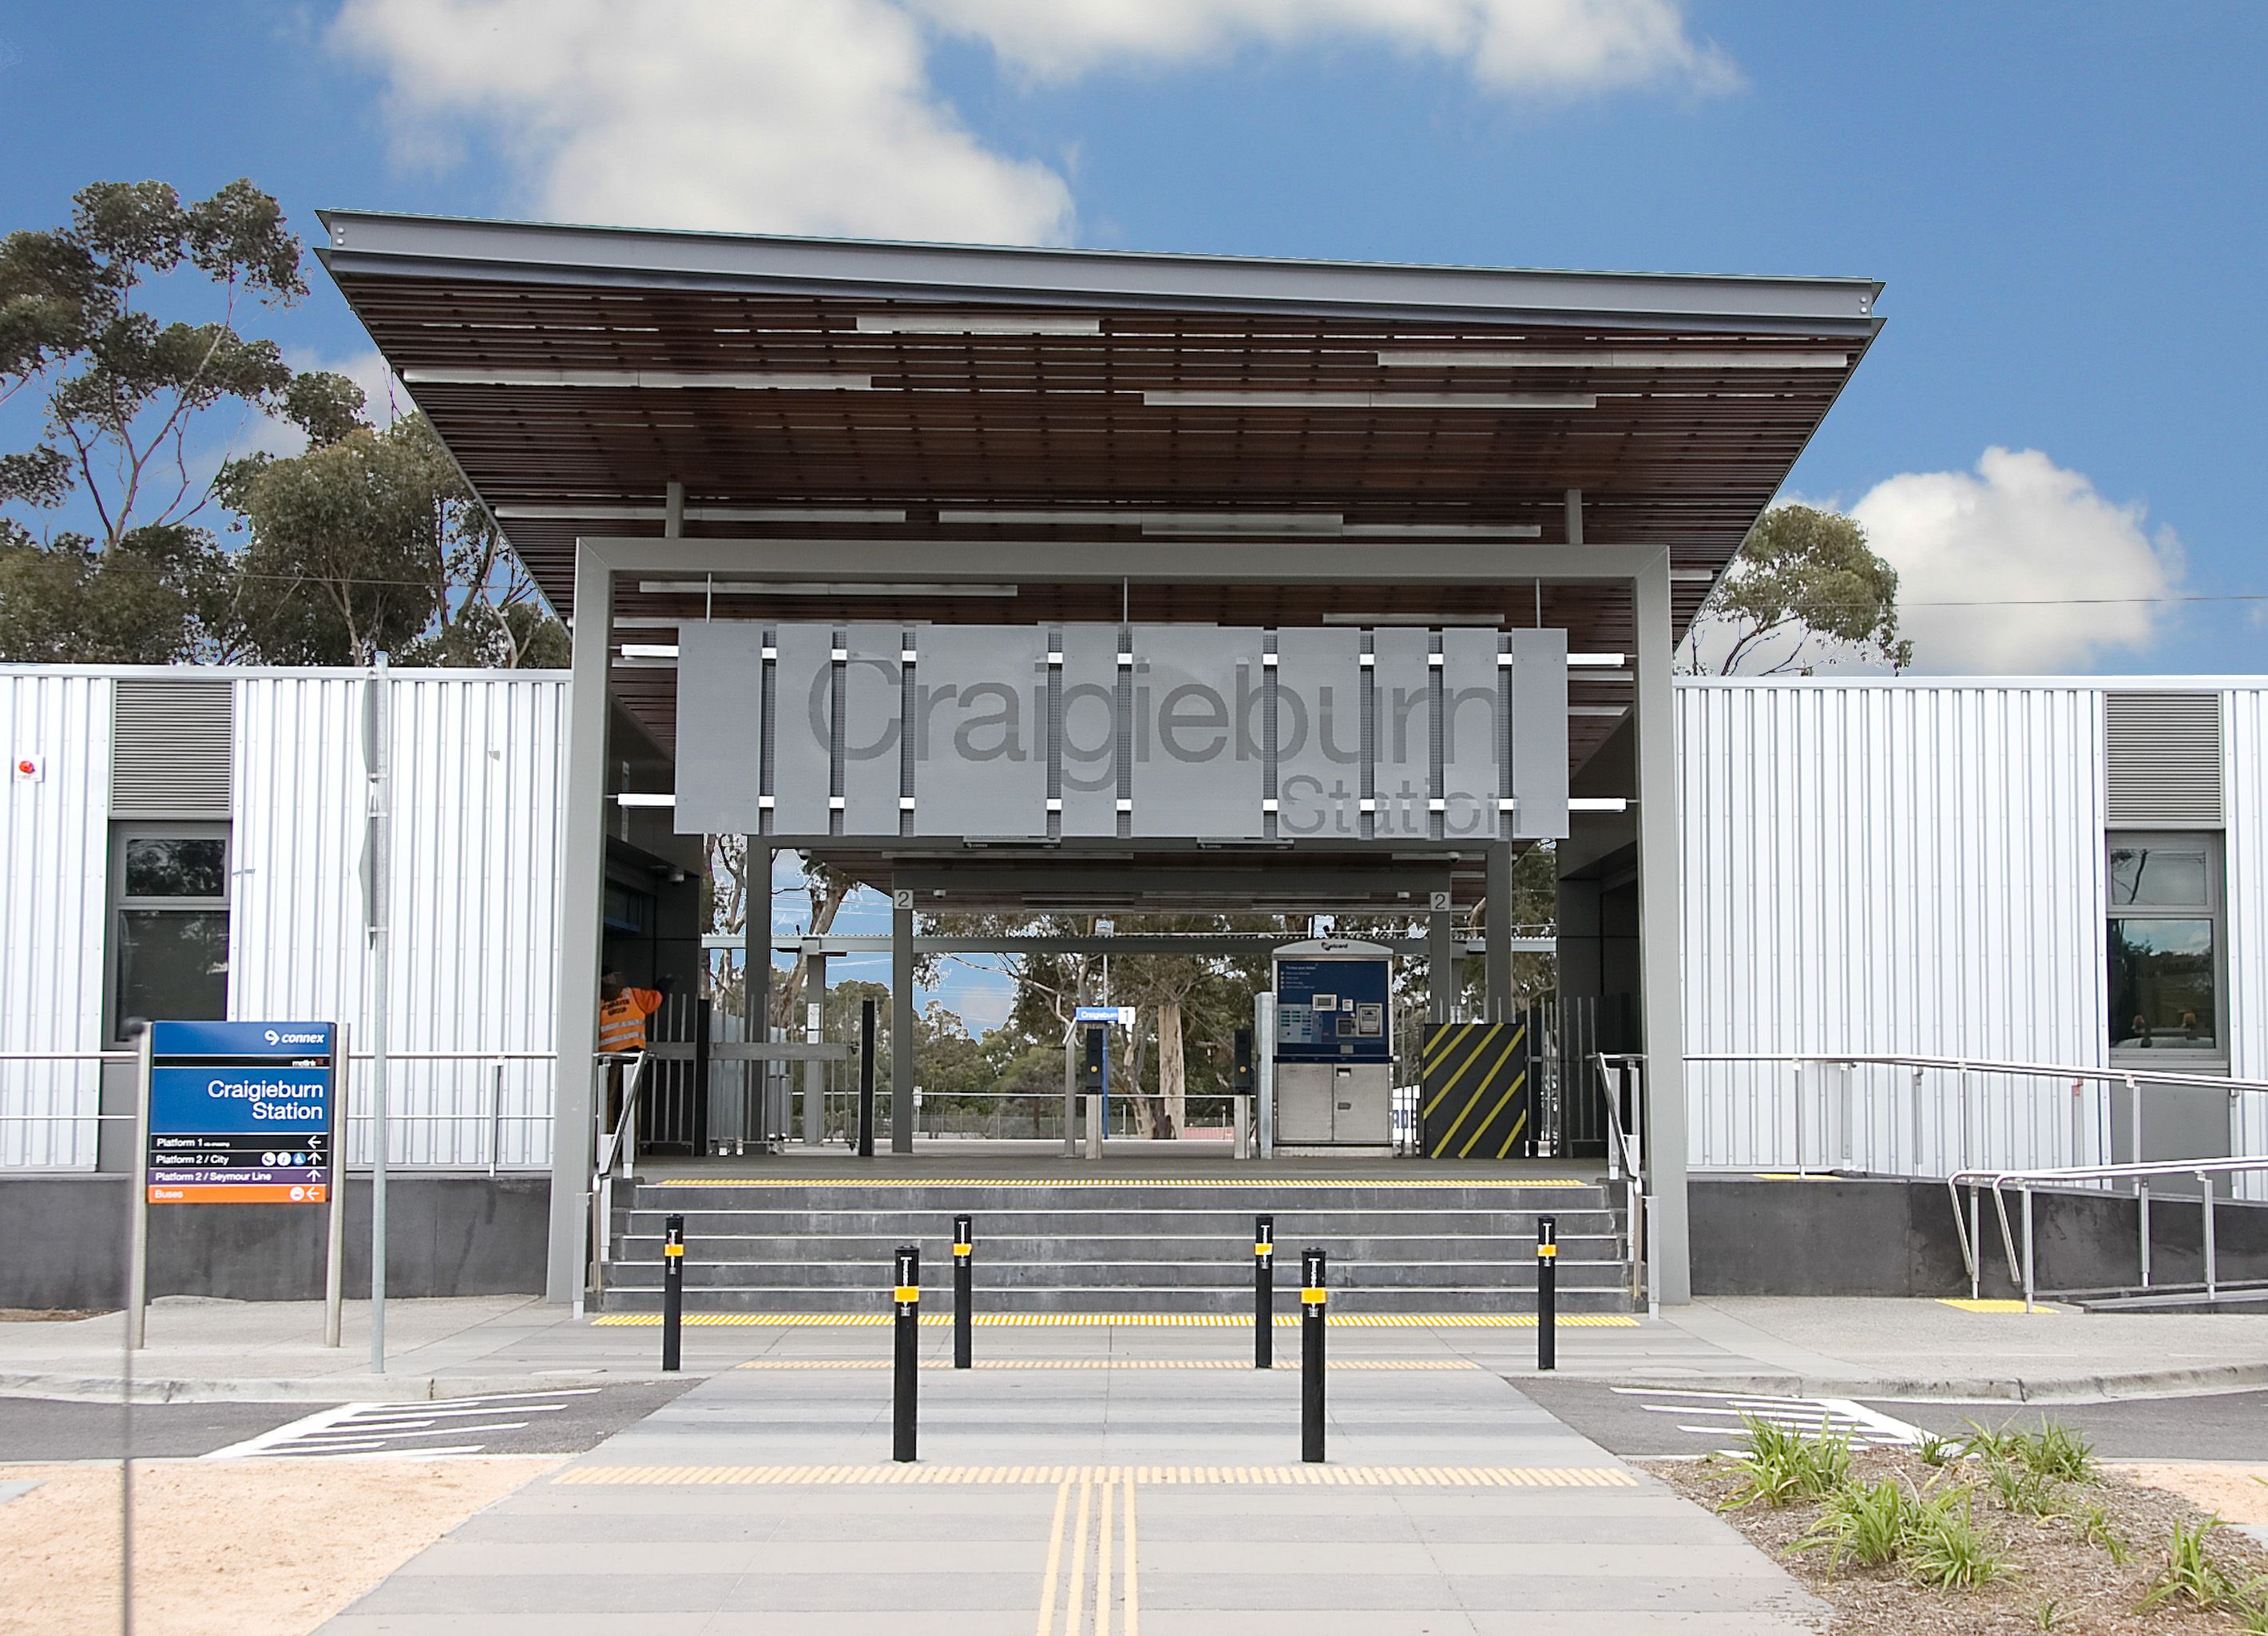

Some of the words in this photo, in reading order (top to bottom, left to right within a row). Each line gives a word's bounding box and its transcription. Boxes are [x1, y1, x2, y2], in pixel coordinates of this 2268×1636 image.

[808, 655, 1506, 792] Craigieburn
[1280, 775, 1521, 834] Station
[898, 891, 909, 907] 2
[1435, 894, 1445, 909] 2
[1124, 1010, 1128, 1022] 1
[281, 1033, 325, 1043] connex
[208, 1079, 324, 1102] Craigieburn
[252, 1102, 323, 1120] Station
[157, 1138, 195, 1147] Platform
[197, 1138, 203, 1147] 1
[156, 1154, 195, 1164] Platform
[196, 1154, 203, 1164] 2
[203, 1154, 209, 1164] /
[210, 1154, 229, 1165] City
[155, 1172, 194, 1181] Platform
[195, 1172, 202, 1181] 2
[203, 1172, 208, 1181] /
[210, 1172, 251, 1182] Seymour
[252, 1172, 272, 1181] Line
[154, 1189, 184, 1198] Buses
